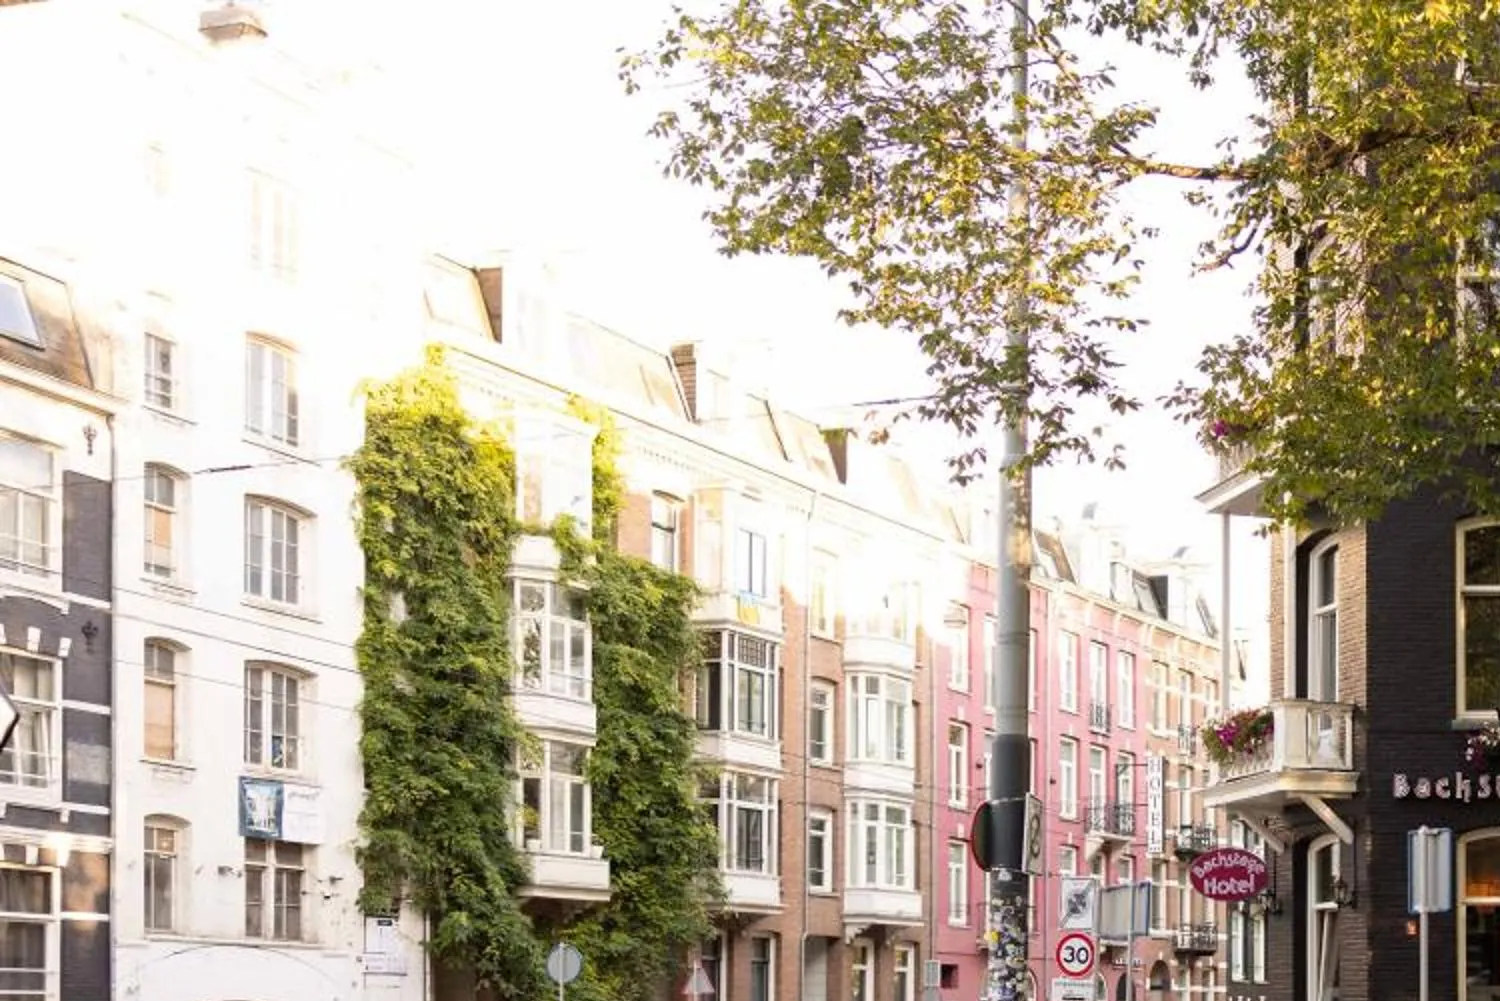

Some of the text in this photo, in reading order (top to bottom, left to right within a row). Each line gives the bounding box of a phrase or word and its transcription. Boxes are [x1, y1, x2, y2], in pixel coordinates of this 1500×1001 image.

[1149, 759, 1161, 844] HOTEL
[1203, 873, 1255, 895] Hotel
[1063, 945, 1089, 965] 30
